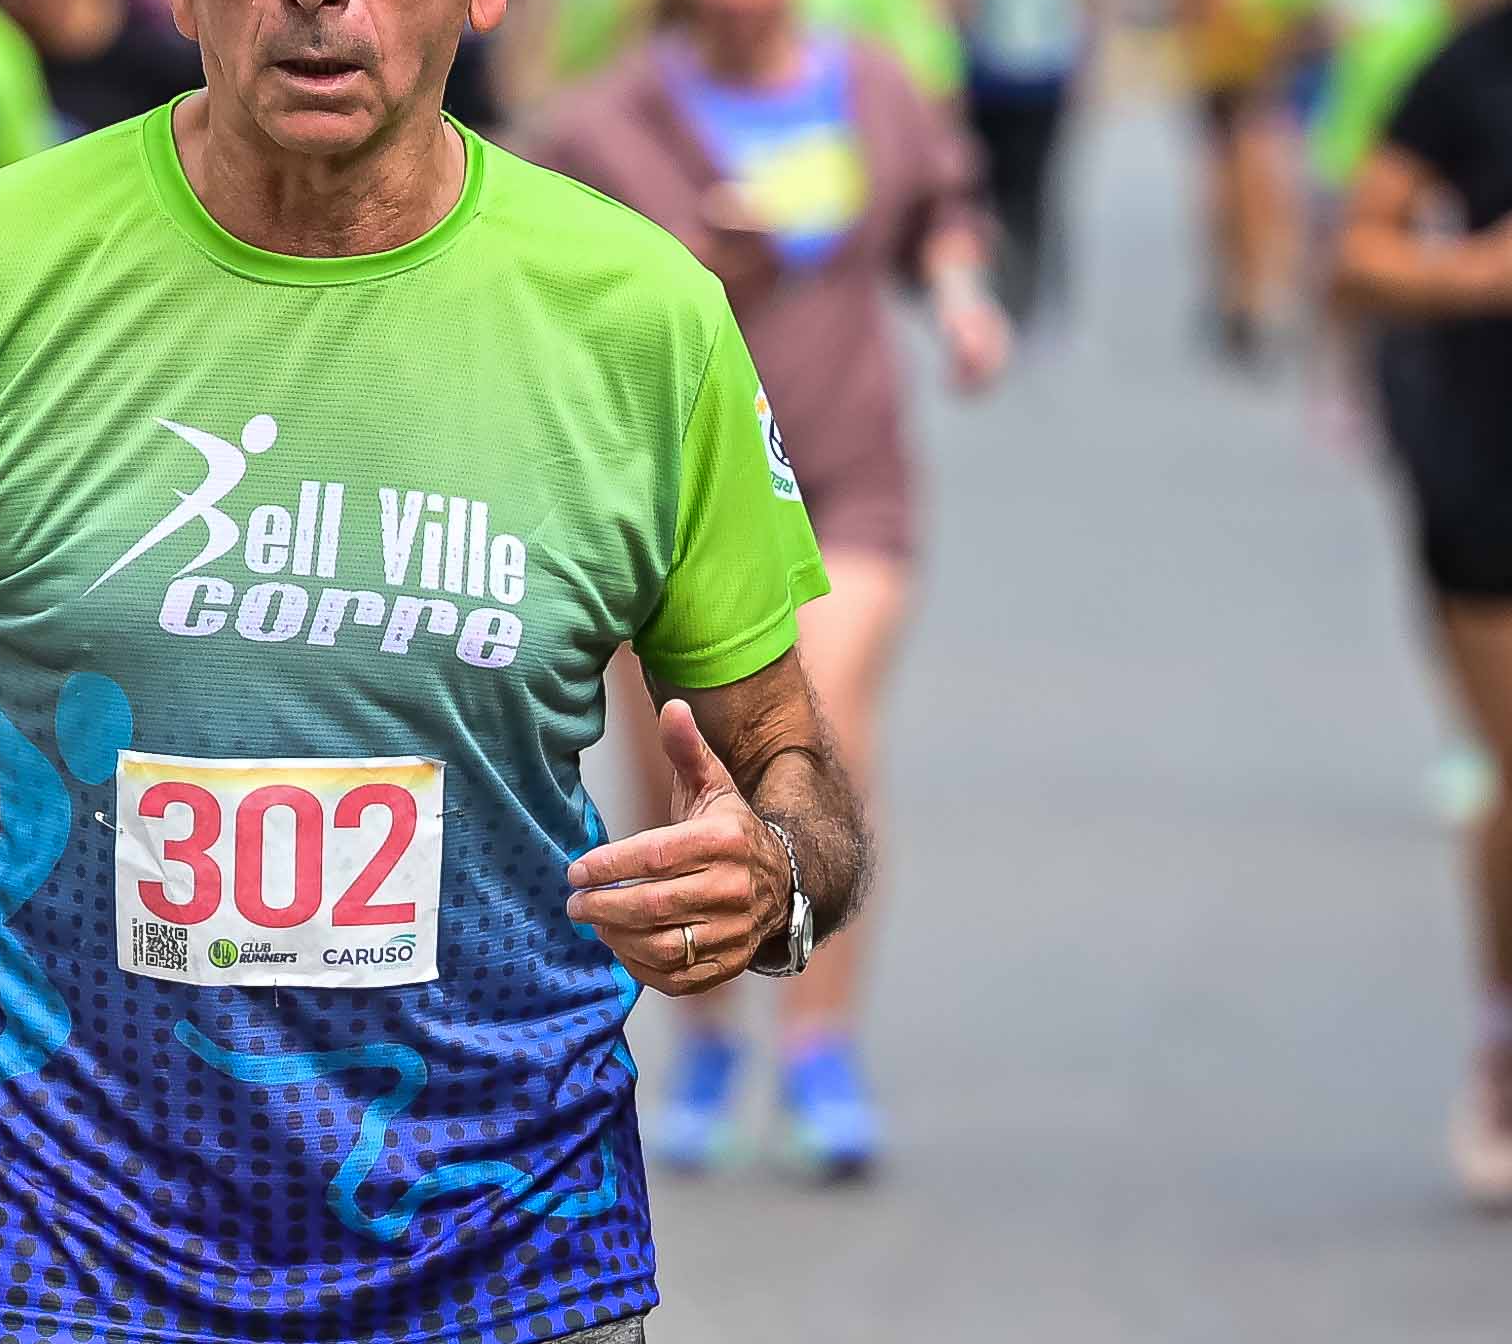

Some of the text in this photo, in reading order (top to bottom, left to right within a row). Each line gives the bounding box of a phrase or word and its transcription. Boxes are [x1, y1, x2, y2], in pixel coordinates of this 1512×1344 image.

[378, 487, 526, 605] Ville
[158, 575, 524, 669] corre
[138, 781, 418, 928] 302
[241, 943, 271, 954] CLUB
[322, 945, 413, 966] CARUSO
